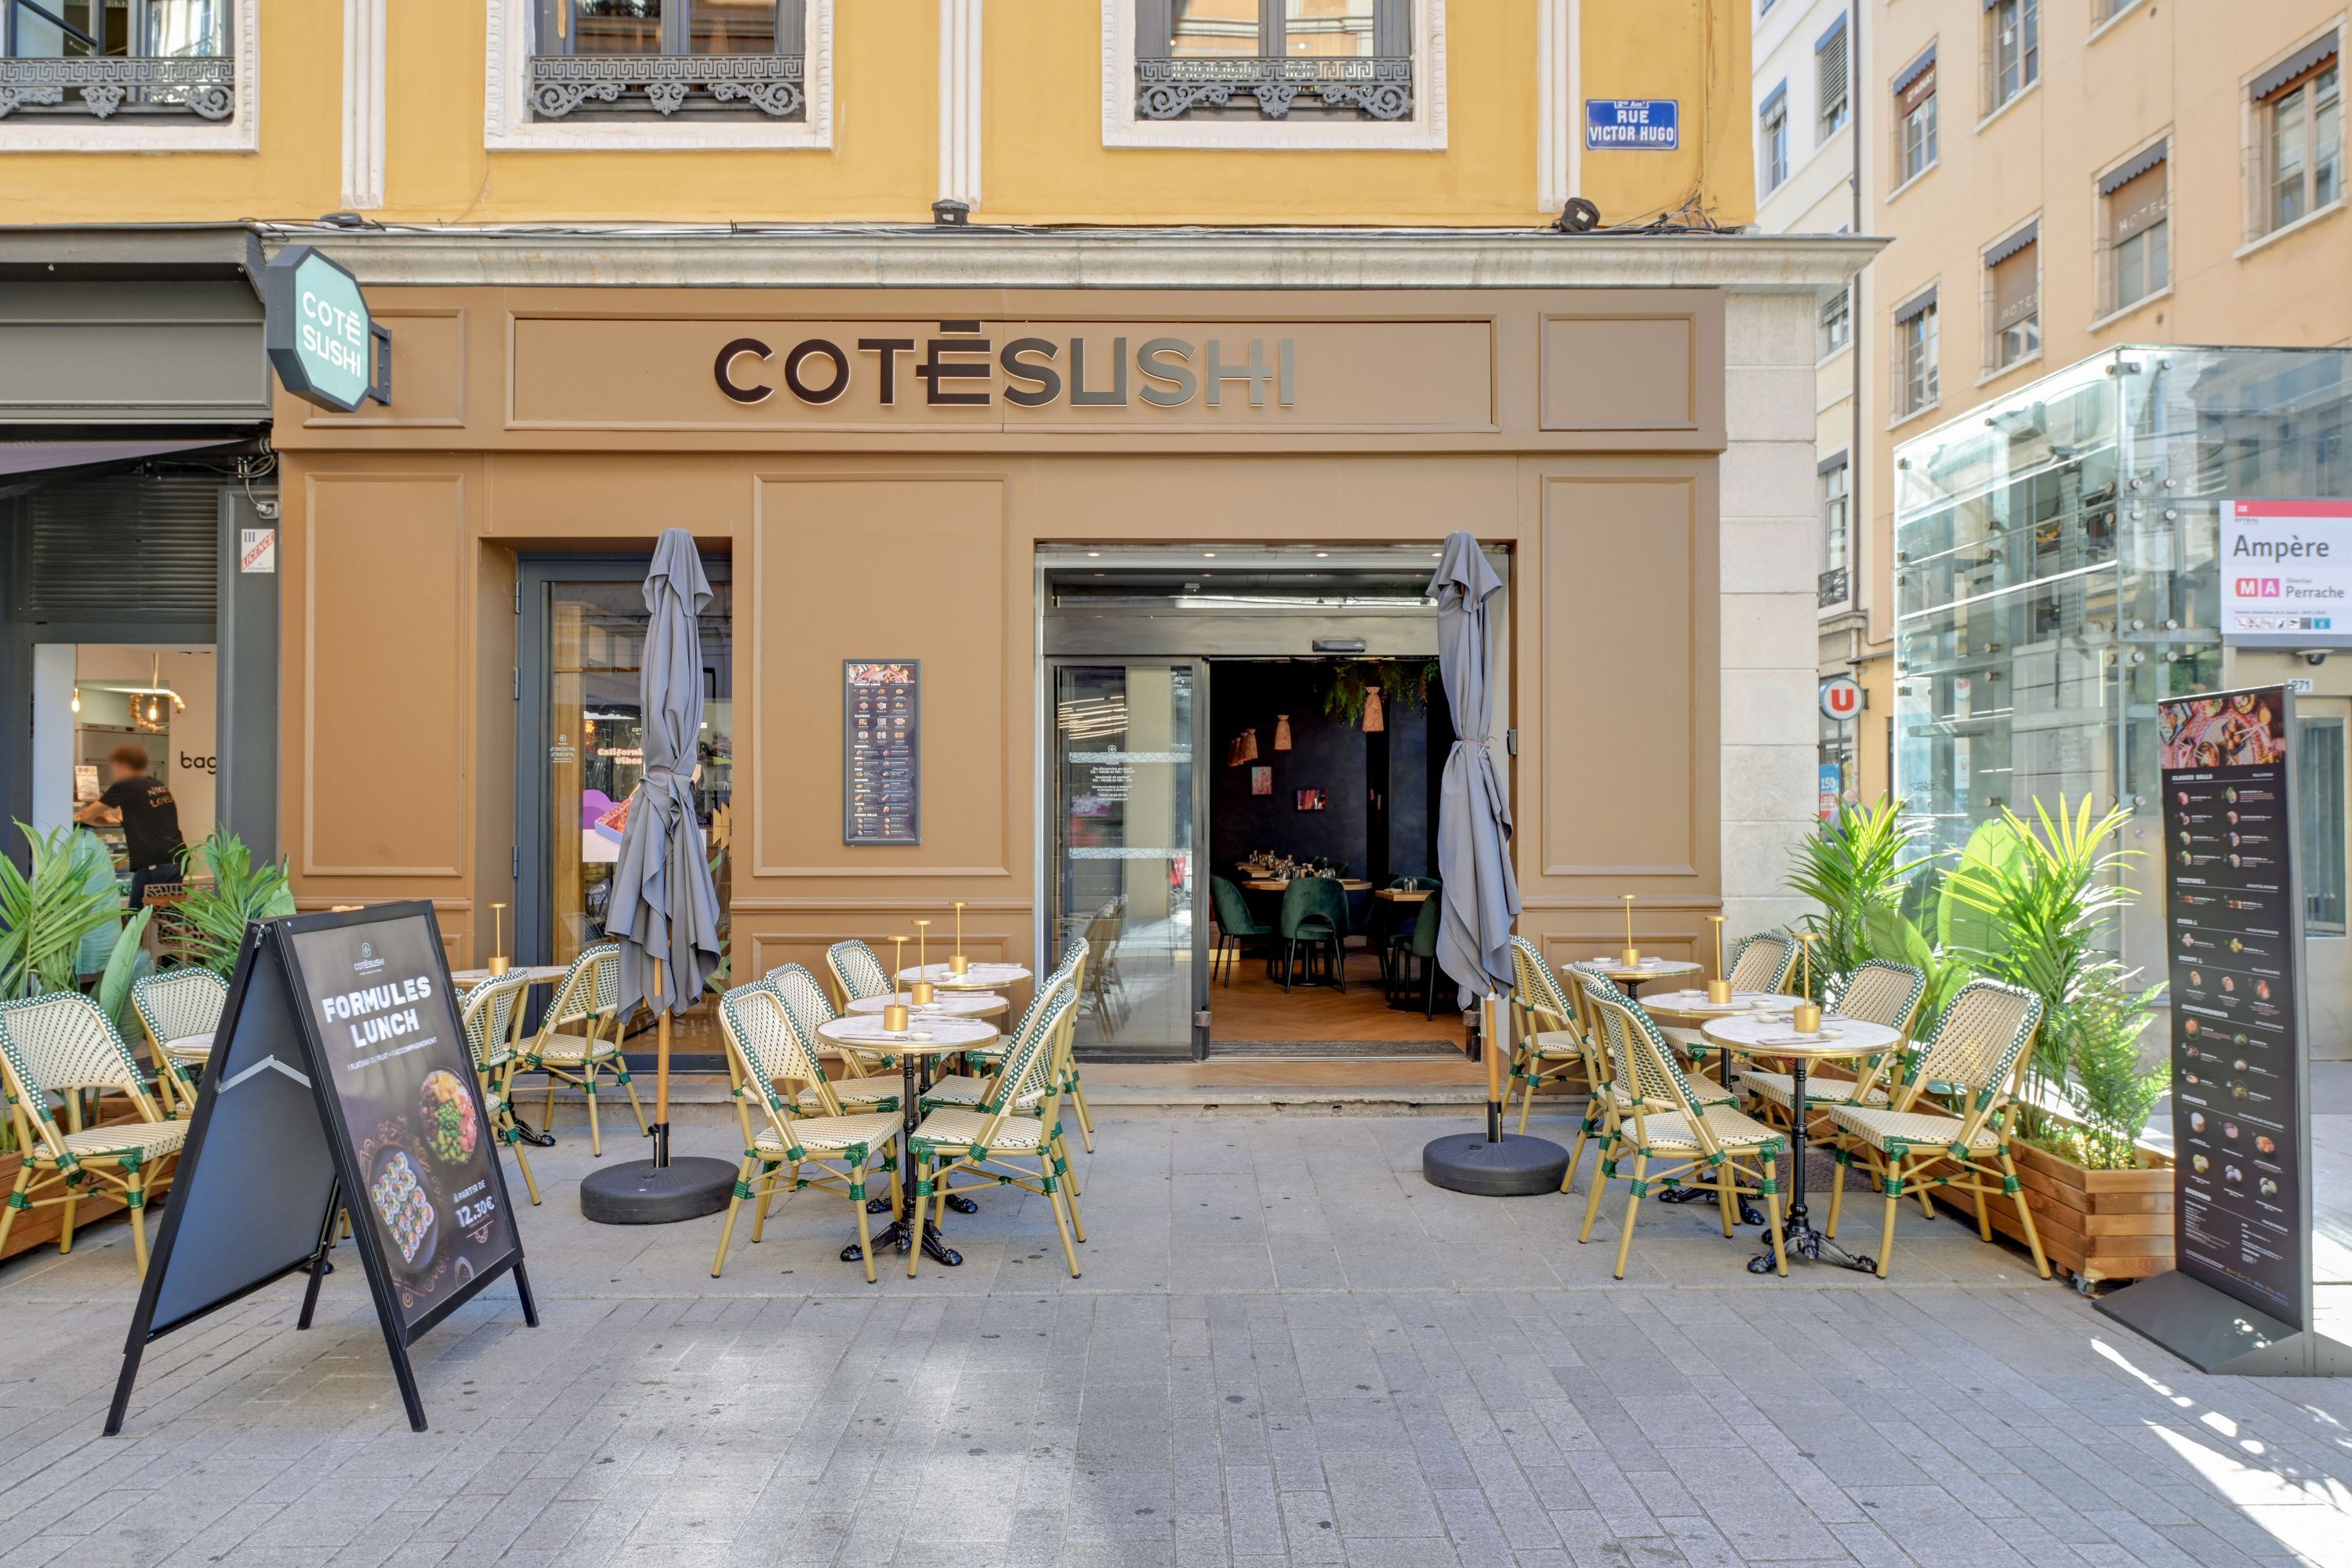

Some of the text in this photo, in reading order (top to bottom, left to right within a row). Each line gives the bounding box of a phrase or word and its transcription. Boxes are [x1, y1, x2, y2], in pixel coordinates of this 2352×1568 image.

[1617, 110, 1650, 124] RUE
[1589, 125, 1674, 142] VICTOR HUGO
[2119, 197, 2167, 233] HOTEL
[303, 324, 361, 378] SUSHI
[244, 532, 256, 542] III
[2233, 535, 2329, 563] Ampère
[242, 530, 274, 570] LICENCE
[2240, 581, 2344, 598] M A Perrache
[1831, 689, 1854, 711] U
[597, 748, 644, 757] Californi
[321, 976, 432, 1022] FORMULES
[350, 1008, 420, 1048] LUNCH
[458, 1185, 479, 1201] PARTIR
[477, 1179, 486, 1189] DE
[456, 1195, 495, 1228] 12.30€
